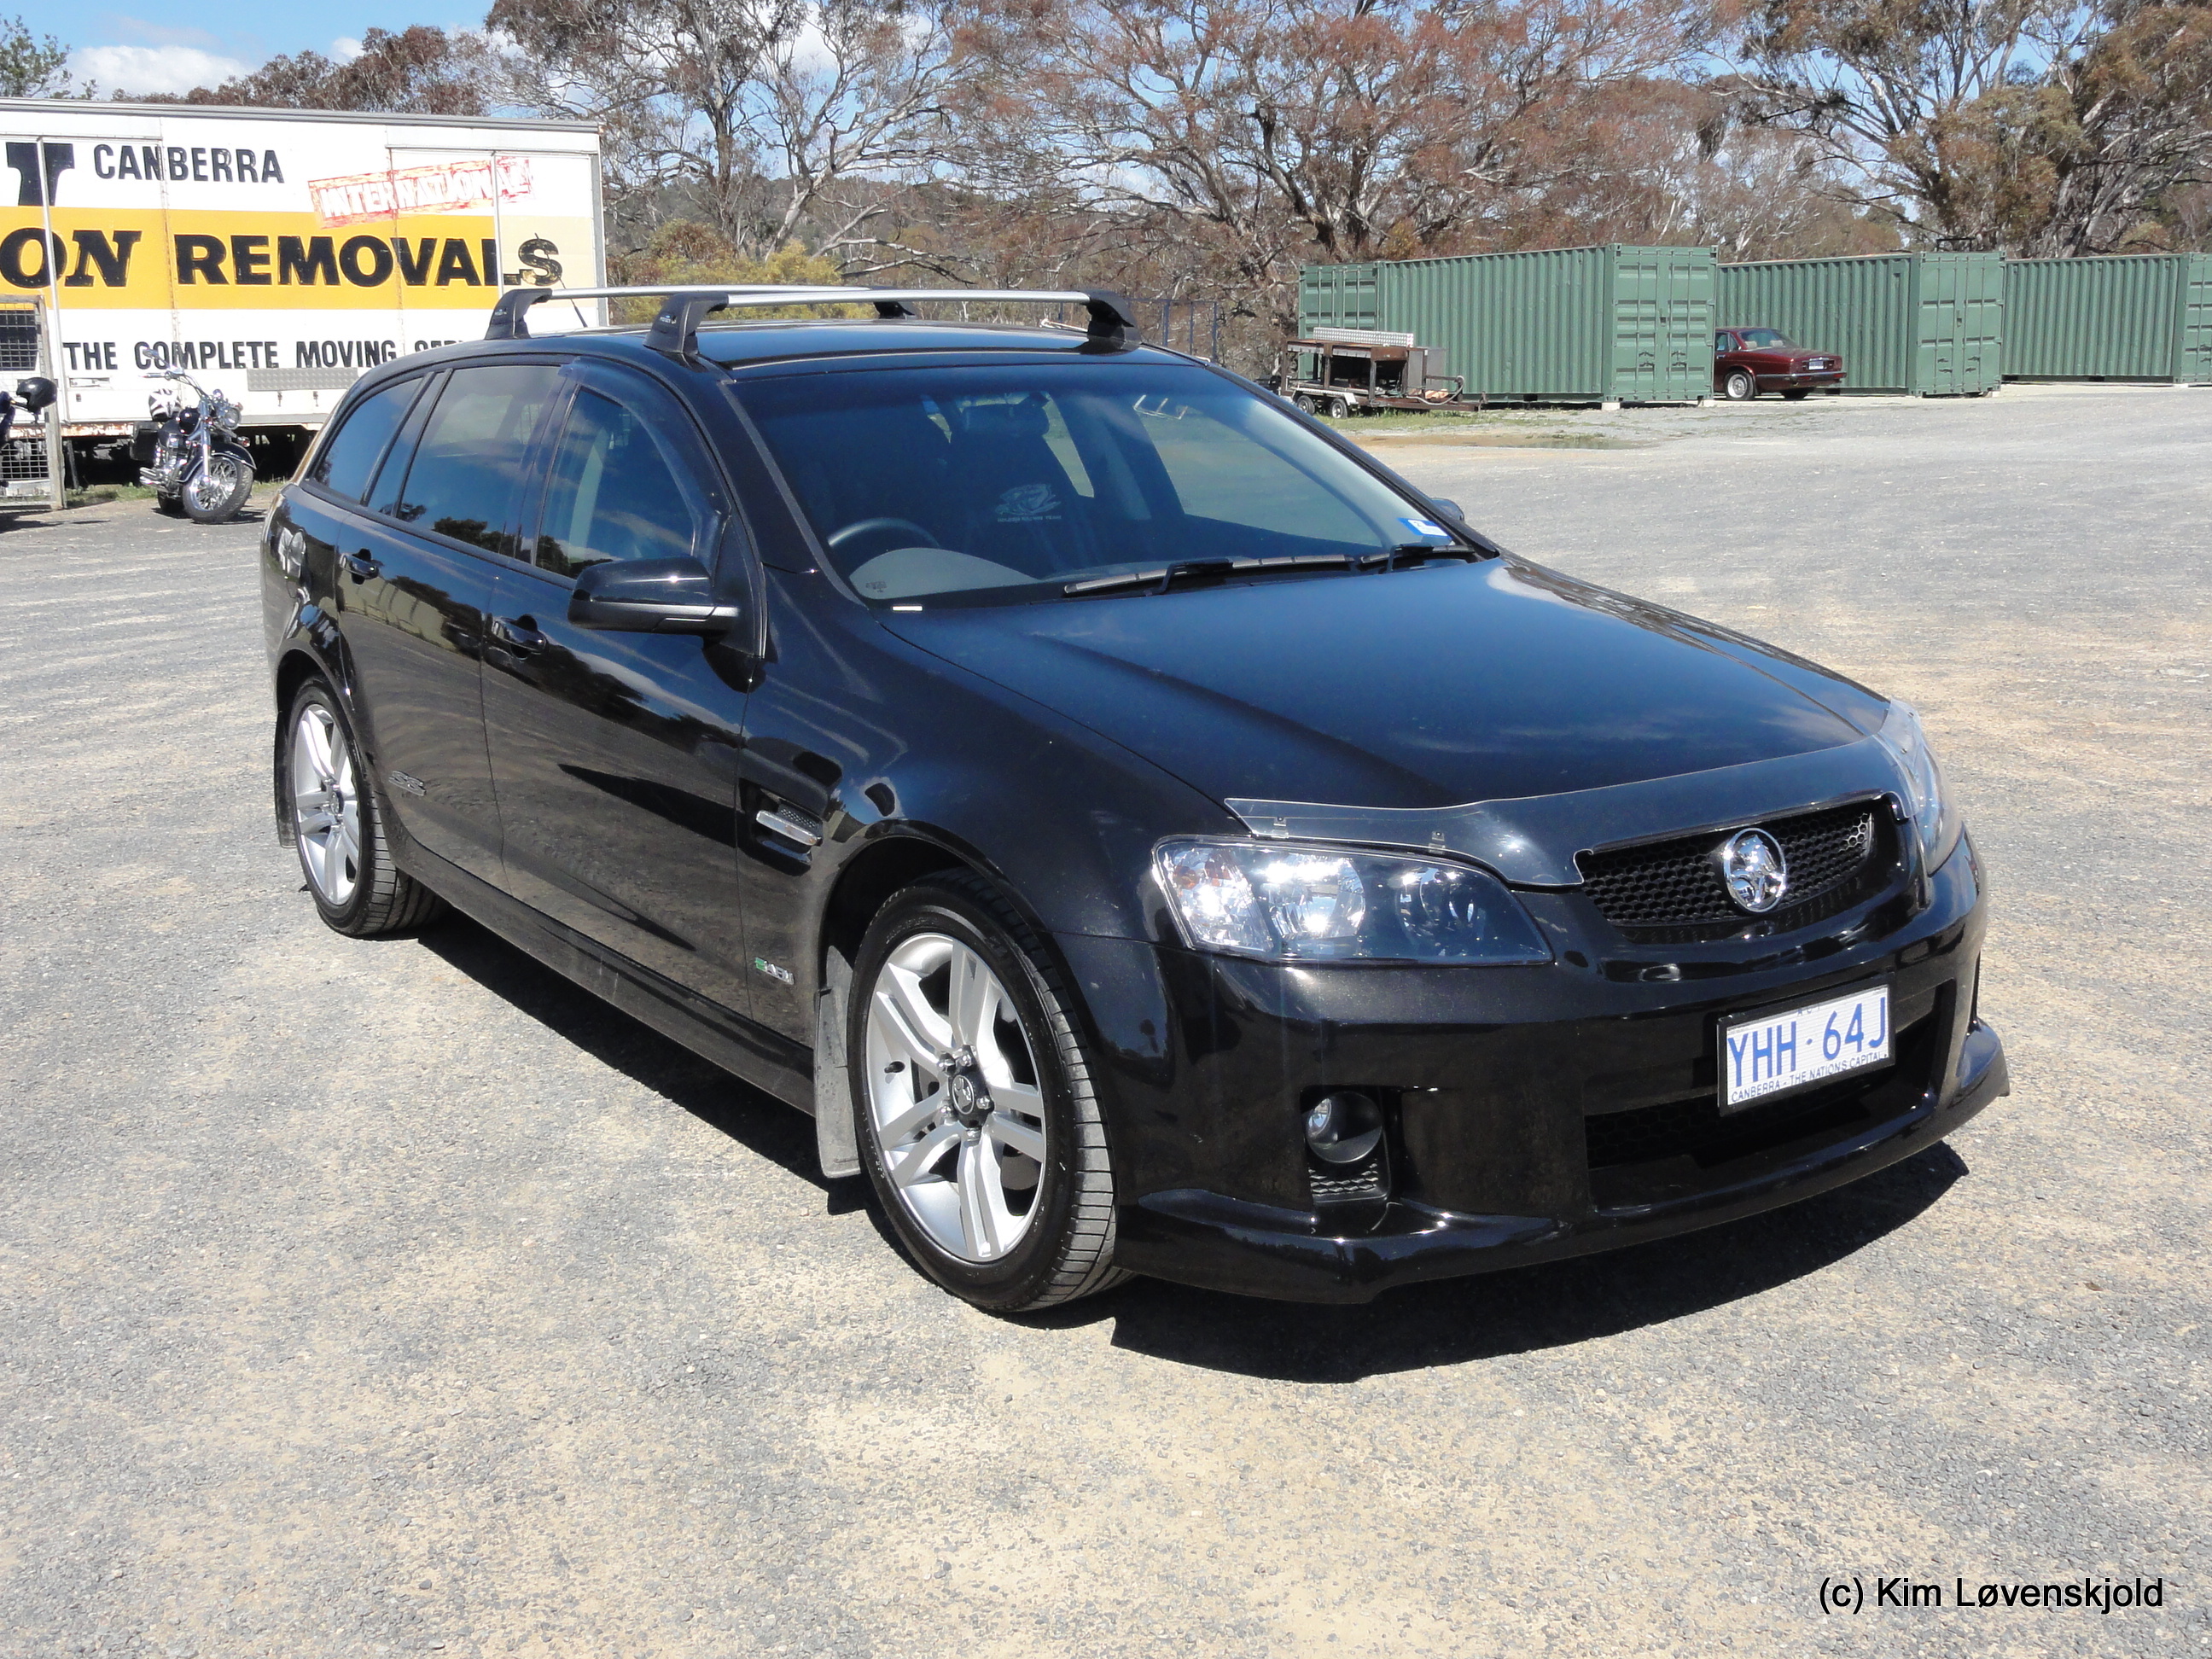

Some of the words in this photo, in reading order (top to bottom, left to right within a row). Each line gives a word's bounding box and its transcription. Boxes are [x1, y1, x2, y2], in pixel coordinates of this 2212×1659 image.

[93, 143, 285, 183] CANBERRA
[318, 165, 531, 219] INTERNATIONAL
[174, 234, 563, 288] REMOVALS
[63, 341, 118, 370] THE
[134, 341, 280, 370] COMPLETE
[296, 340, 397, 369] MOVING
[1727, 1021, 1797, 1087] YHH
[1822, 996, 1886, 1061] 64J
[1731, 1080, 1781, 1103] CANBERRA
[1790, 1071, 1807, 1086] THE
[1849, 1051, 1884, 1068] CAPITAL
